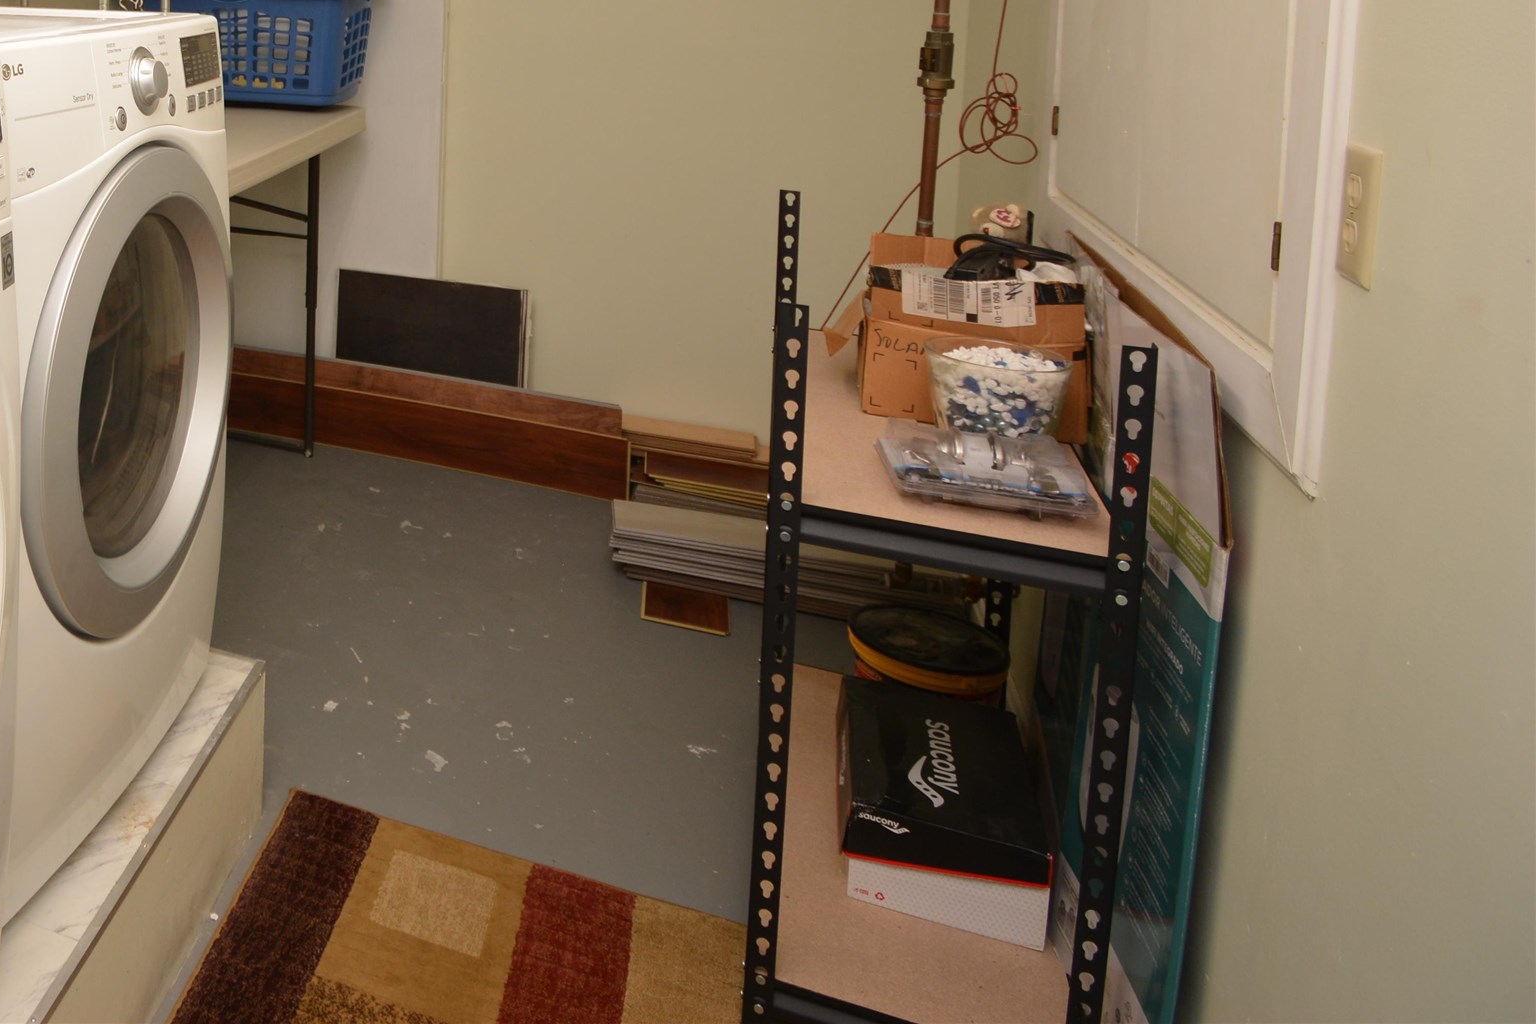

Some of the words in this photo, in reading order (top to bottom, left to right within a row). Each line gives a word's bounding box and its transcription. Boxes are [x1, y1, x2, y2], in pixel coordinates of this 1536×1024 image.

[12, 63, 24, 77] LG
[72, 94, 85, 105] Sensor
[86, 92, 94, 104] Dry
[925, 718, 960, 796] saucony
[858, 810, 900, 829] saucony
